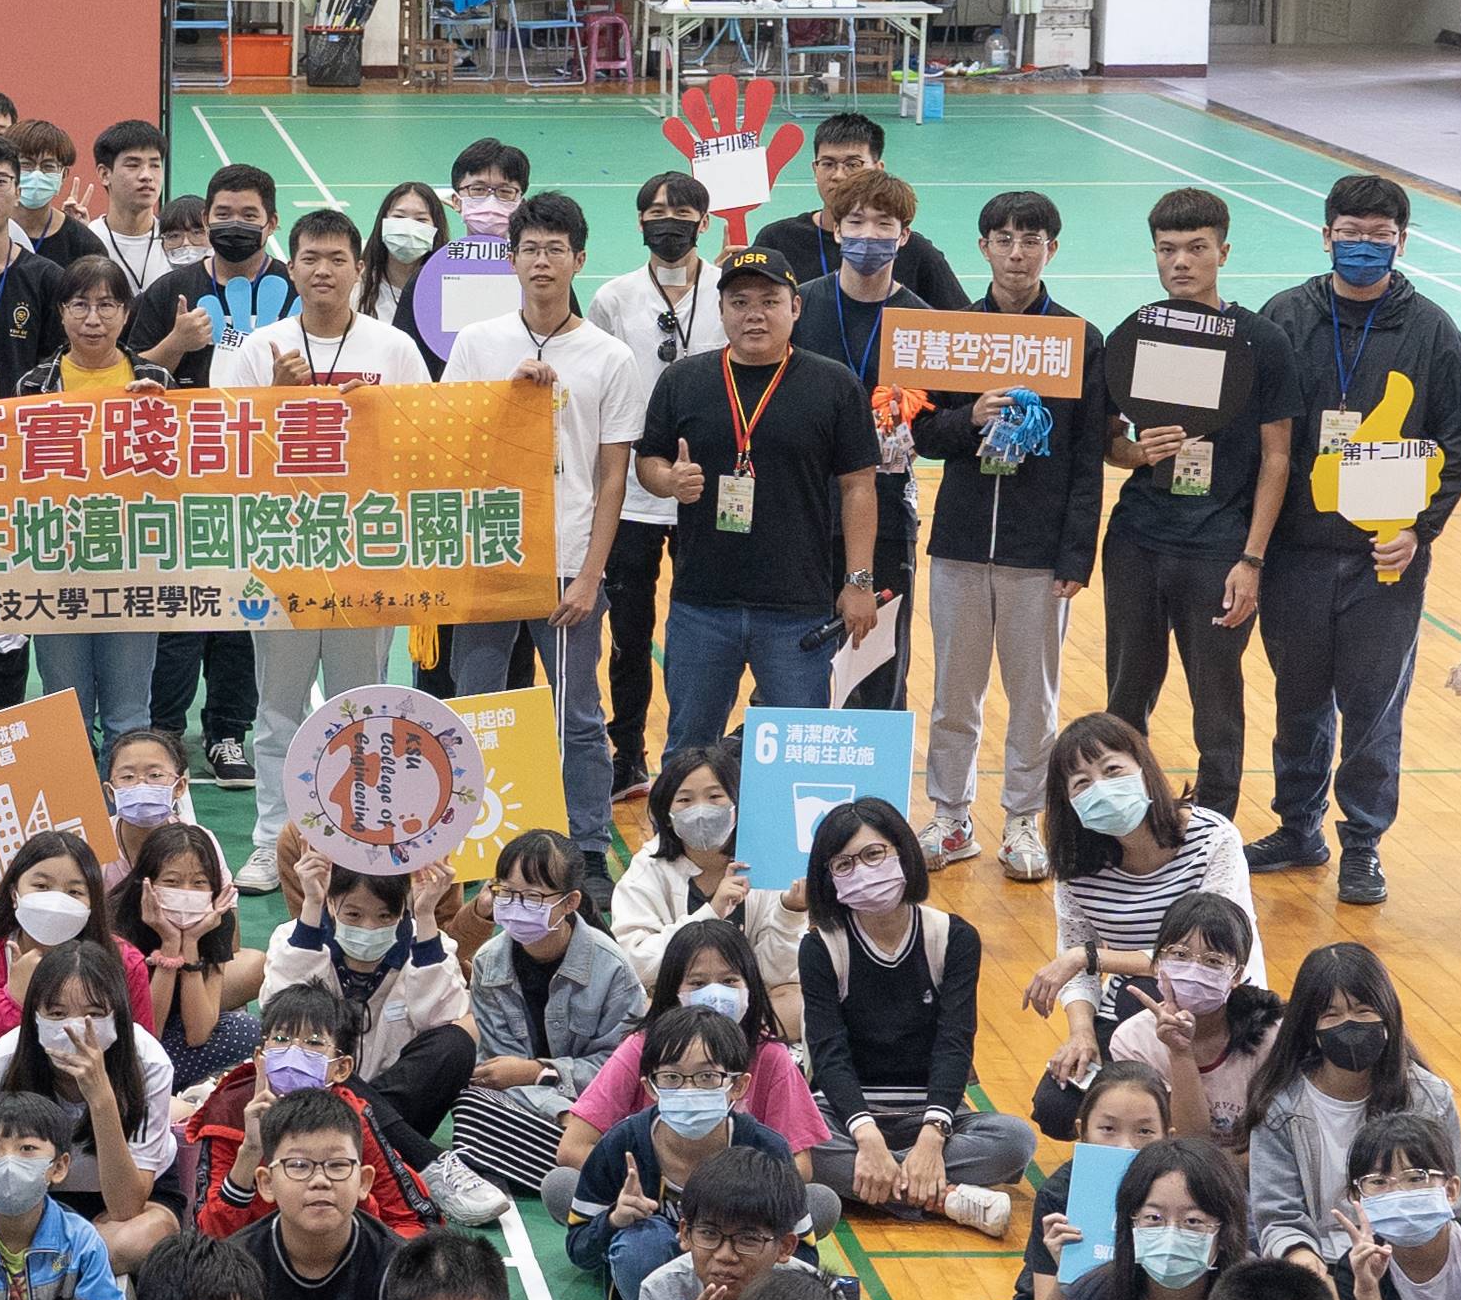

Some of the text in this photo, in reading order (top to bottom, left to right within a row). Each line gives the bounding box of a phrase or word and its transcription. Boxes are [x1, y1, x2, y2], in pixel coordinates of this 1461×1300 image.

[733, 253, 768, 268] USR
[891, 327, 1073, 380] 智慧空污防制
[405, 732, 422, 770] KSU
[754, 722, 780, 764] 6
[785, 724, 858, 744] 清潔飲水
[784, 744, 876, 766] 與衛生設施
[351, 732, 371, 834] Engineering
[379, 732, 397, 828] College of
